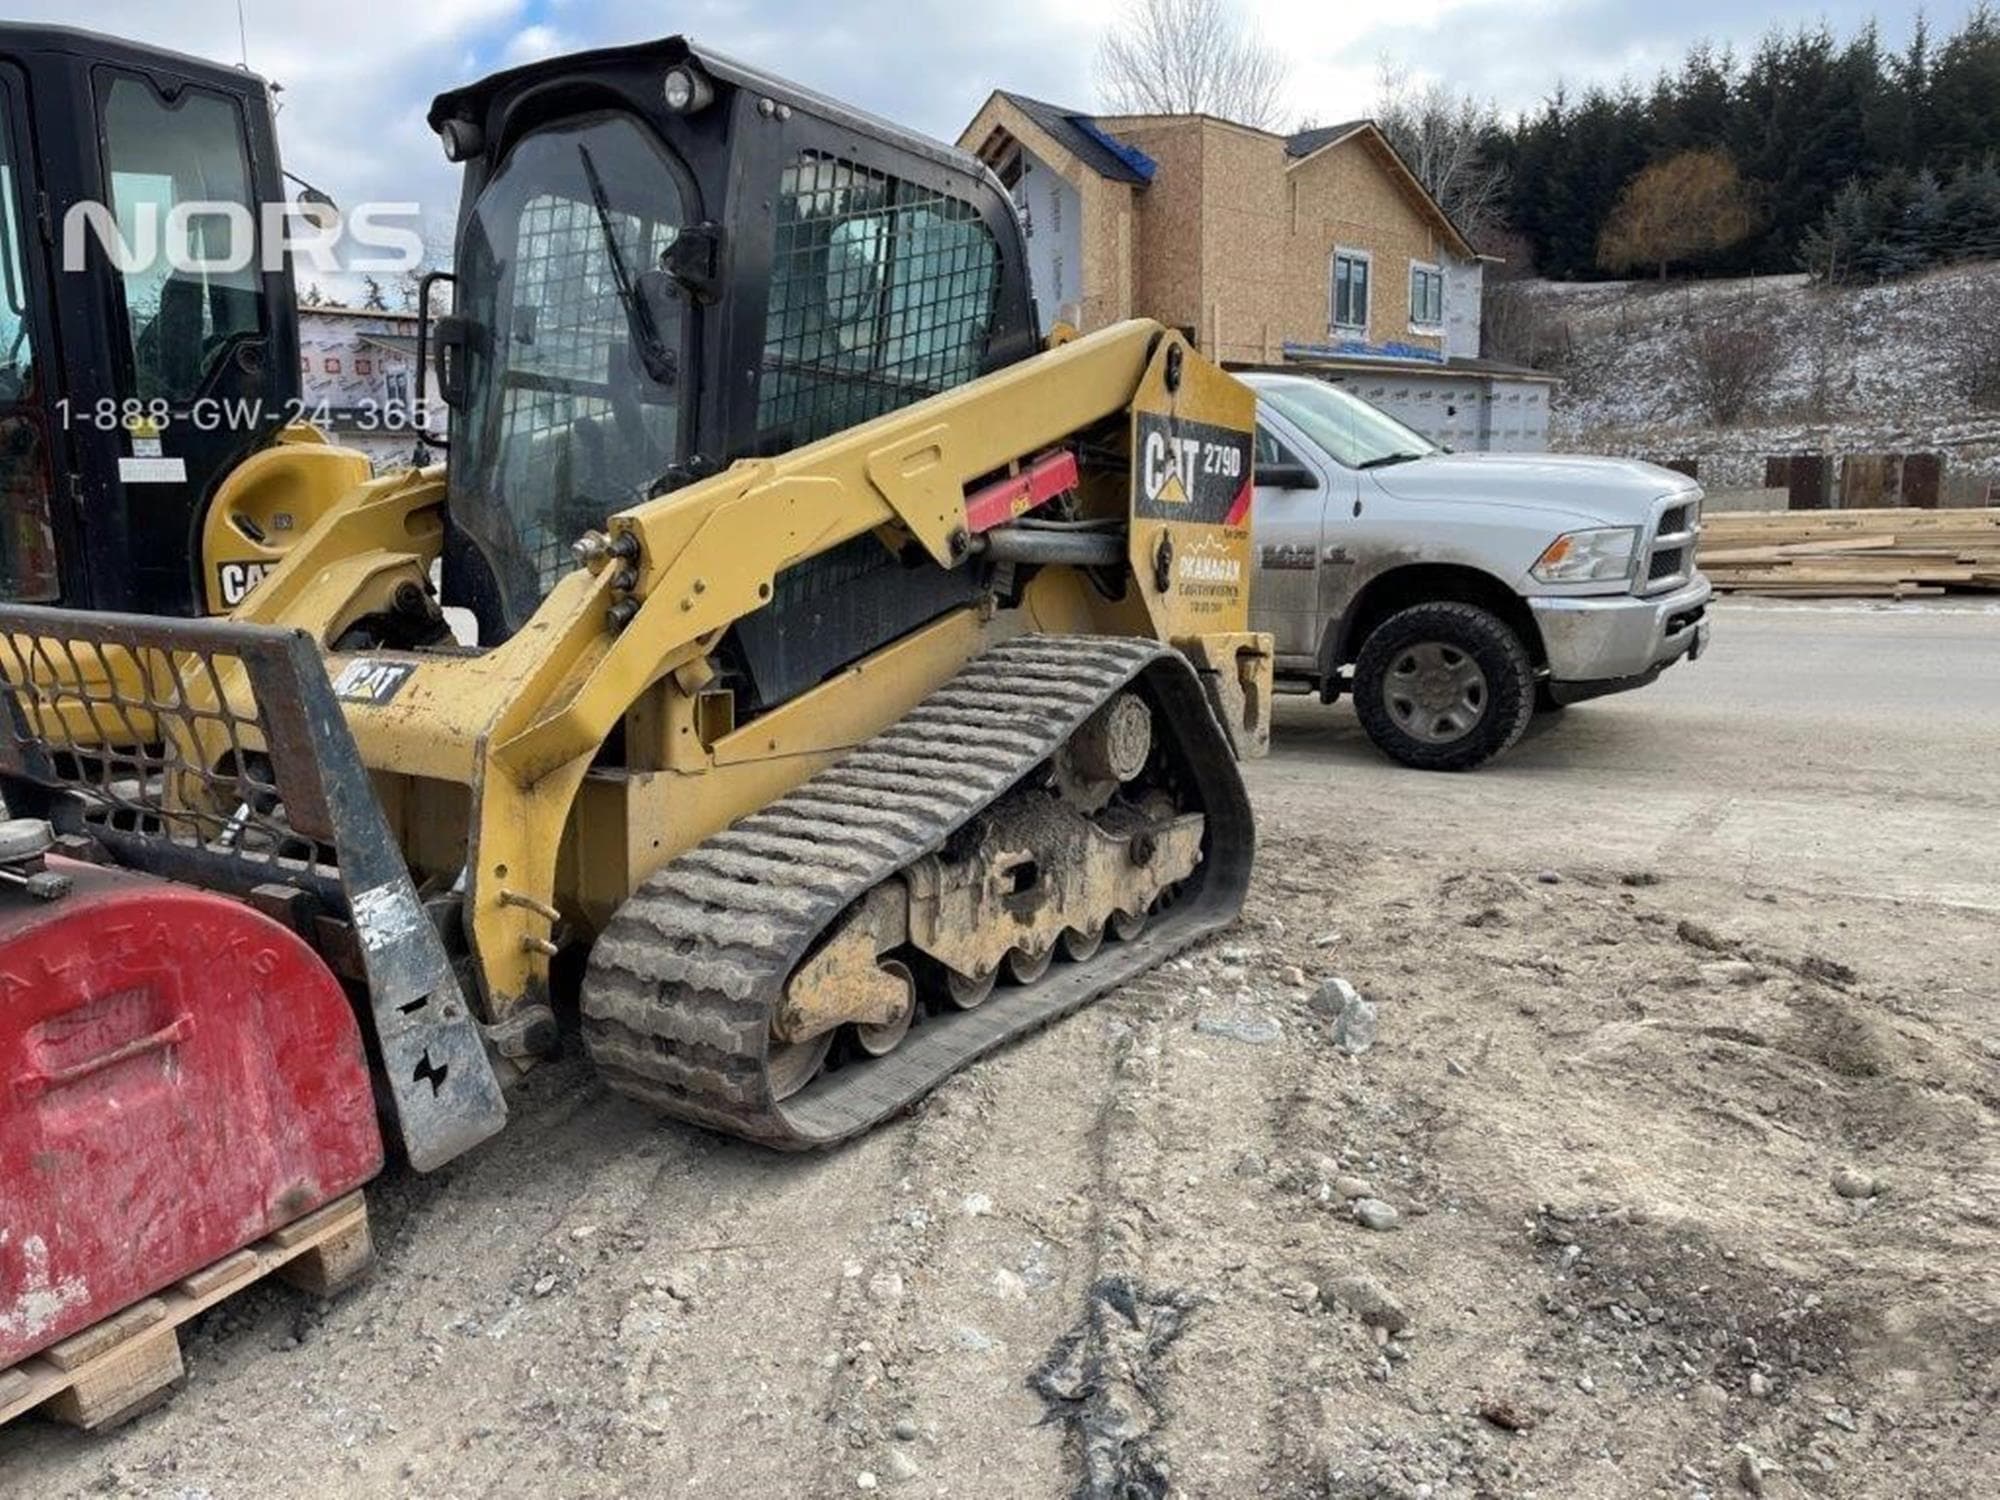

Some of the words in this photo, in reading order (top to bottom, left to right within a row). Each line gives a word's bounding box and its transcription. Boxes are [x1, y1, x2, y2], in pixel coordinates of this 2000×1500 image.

[1145, 431, 1199, 503] CAT
[1204, 442, 1241, 477] 279D
[336, 659, 405, 698] CAT
